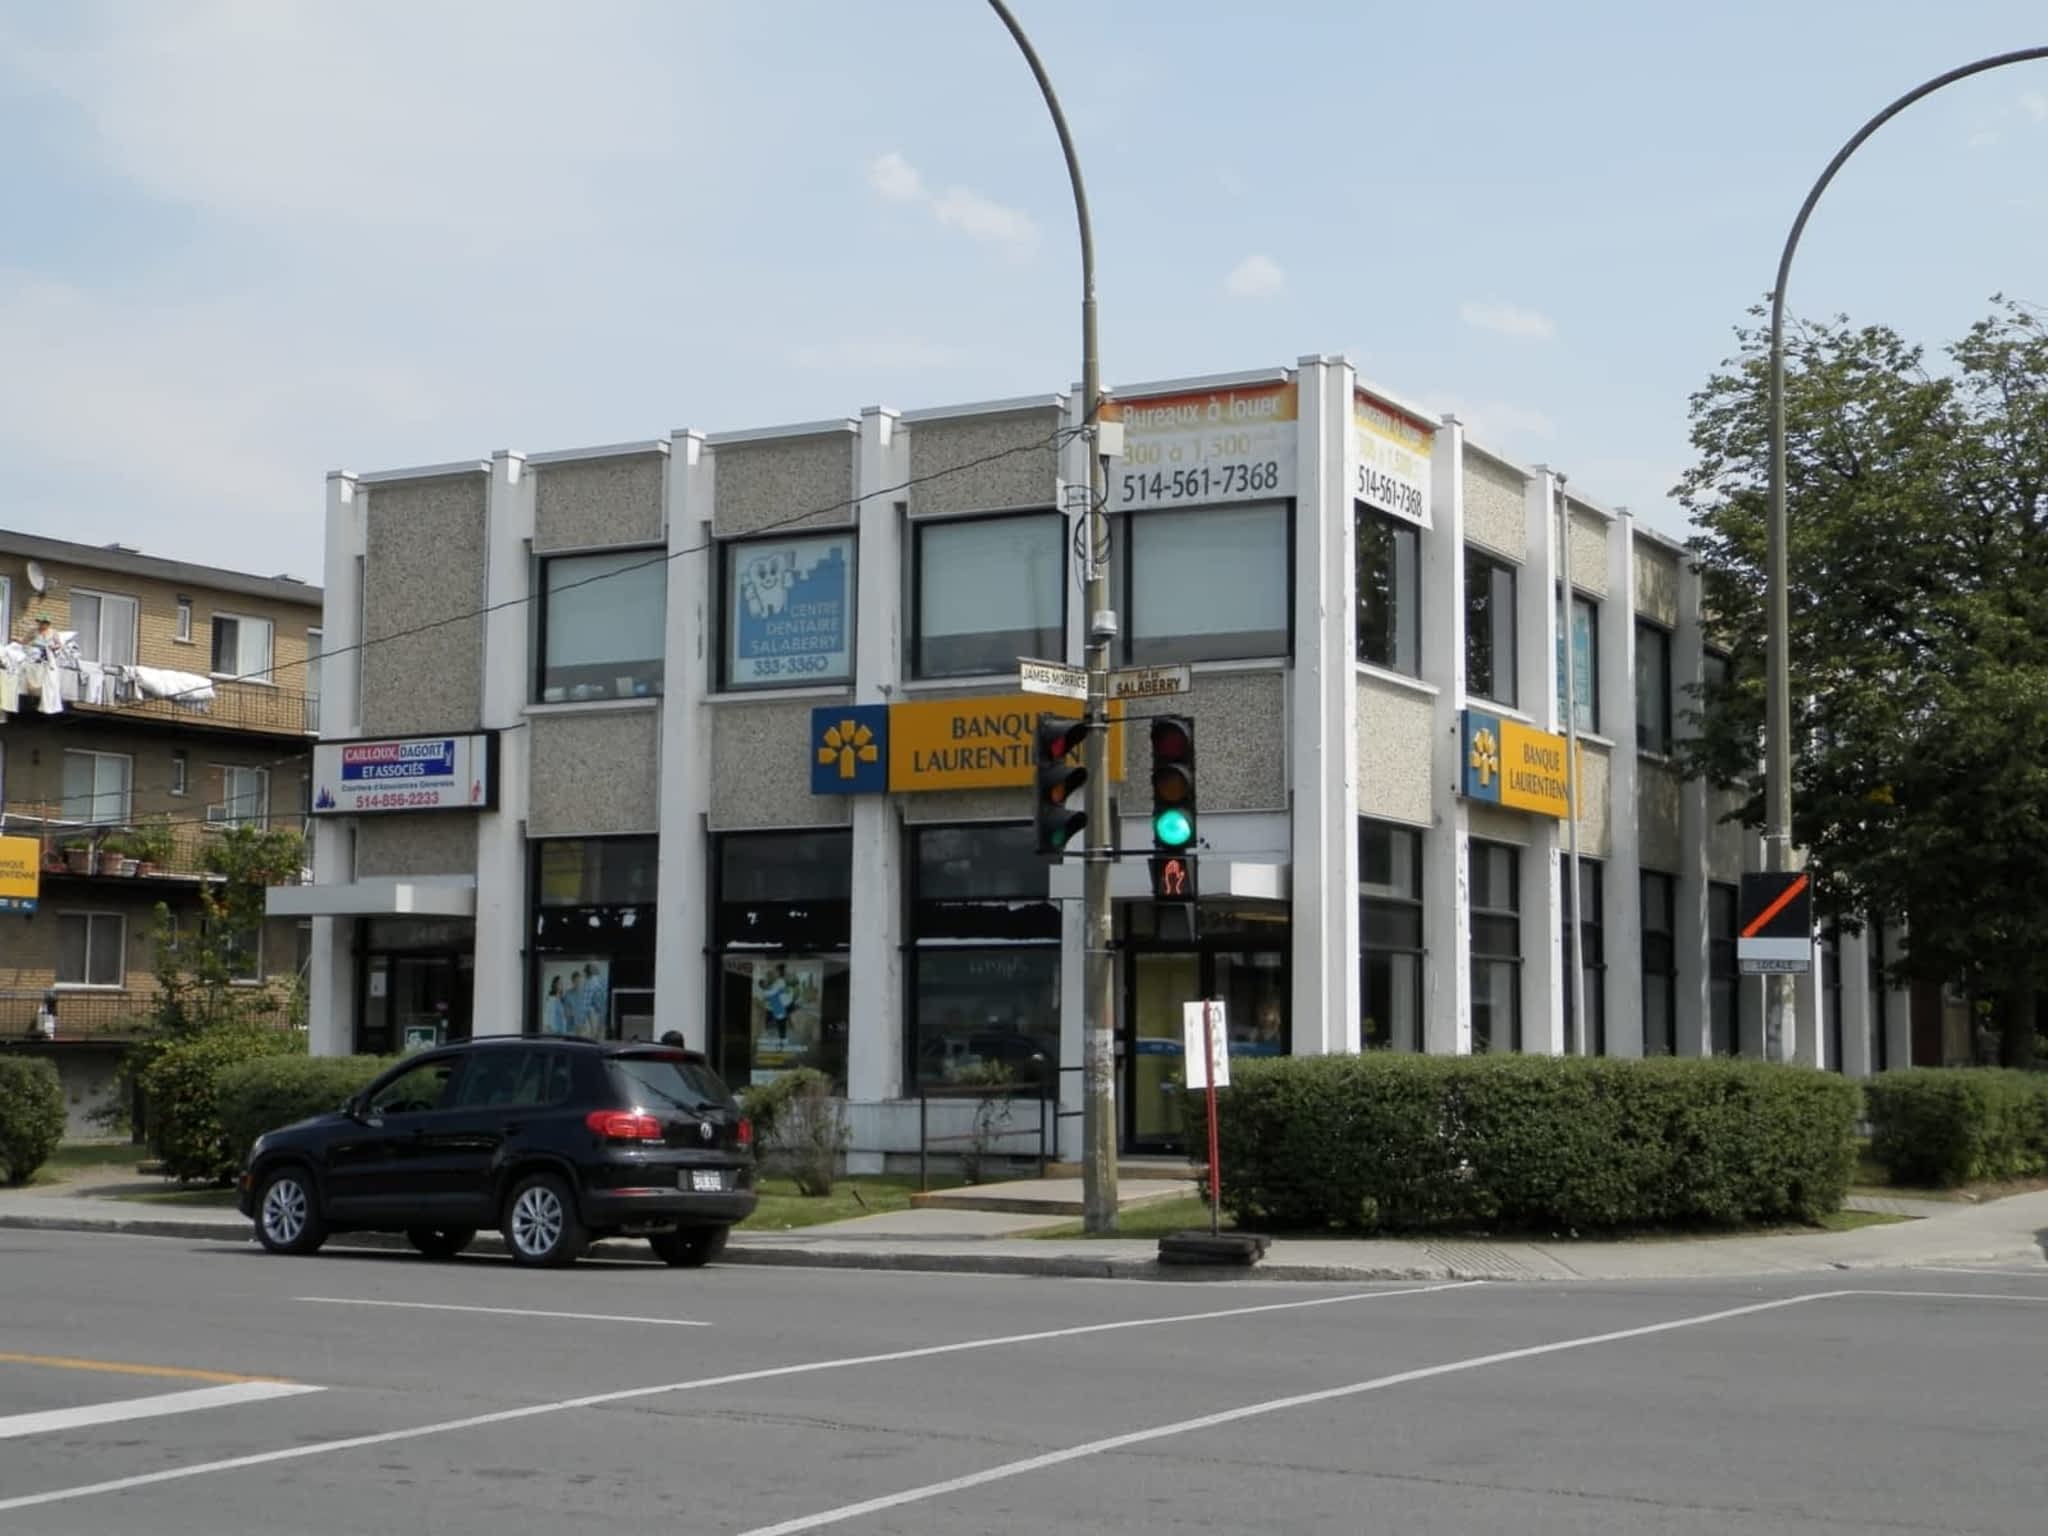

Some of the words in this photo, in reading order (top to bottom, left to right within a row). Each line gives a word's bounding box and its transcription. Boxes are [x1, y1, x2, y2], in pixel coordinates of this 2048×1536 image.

[1122, 402, 1200, 429] Bureaux
[1230, 394, 1281, 418] louer
[1122, 461, 1278, 503] 514-561-7368
[1358, 464, 1422, 518] 514-561-7368
[791, 601, 840, 617] CENTRE
[767, 617, 840, 635] DENTAIRE
[751, 635, 837, 652] SALABERRY
[1023, 667, 1049, 682] JAMES
[1116, 677, 1181, 696] SALABERRY
[1523, 741, 1560, 773] BANQUE
[362, 766, 375, 779] ET
[1509, 767, 1569, 801] LAURENTIENN
